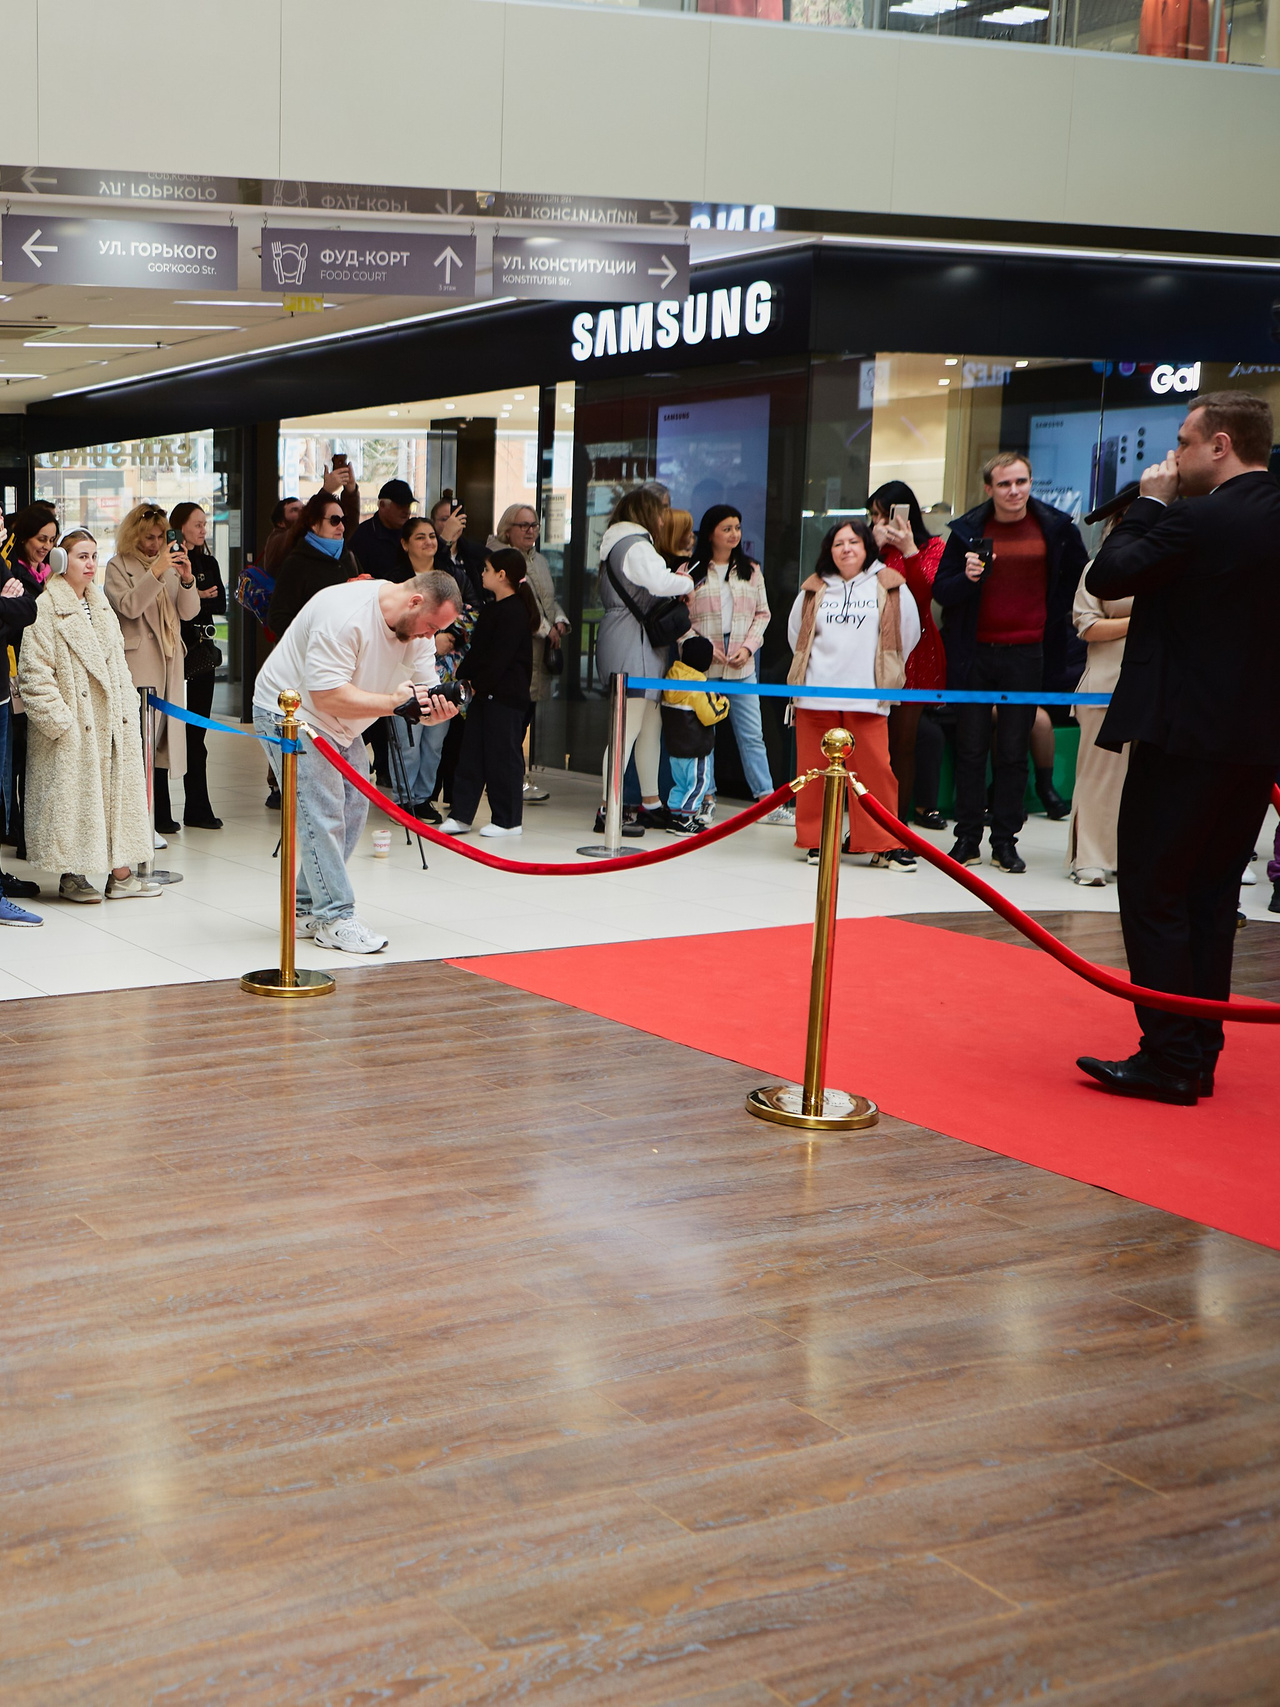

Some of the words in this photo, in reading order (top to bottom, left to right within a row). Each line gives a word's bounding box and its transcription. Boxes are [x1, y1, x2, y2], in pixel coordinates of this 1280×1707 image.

[98, 240, 126, 256] УЛ.
[131, 241, 217, 260] ГОРЬКОГО
[320, 248, 410, 267] ФУД-КОРТ
[148, 262, 200, 274] GOR'KOGO
[202, 264, 217, 275] Str.
[502, 256, 526, 270] УЛ.
[529, 256, 637, 276] КОНСТИТУЦИИ
[320, 270, 351, 281] FOOD
[352, 271, 388, 282] COURT
[502, 274, 557, 285] KONSTITUTSII
[558, 277, 572, 287] Str.
[571, 280, 773, 362] SAMSUNG
[826, 611, 866, 629] irony
